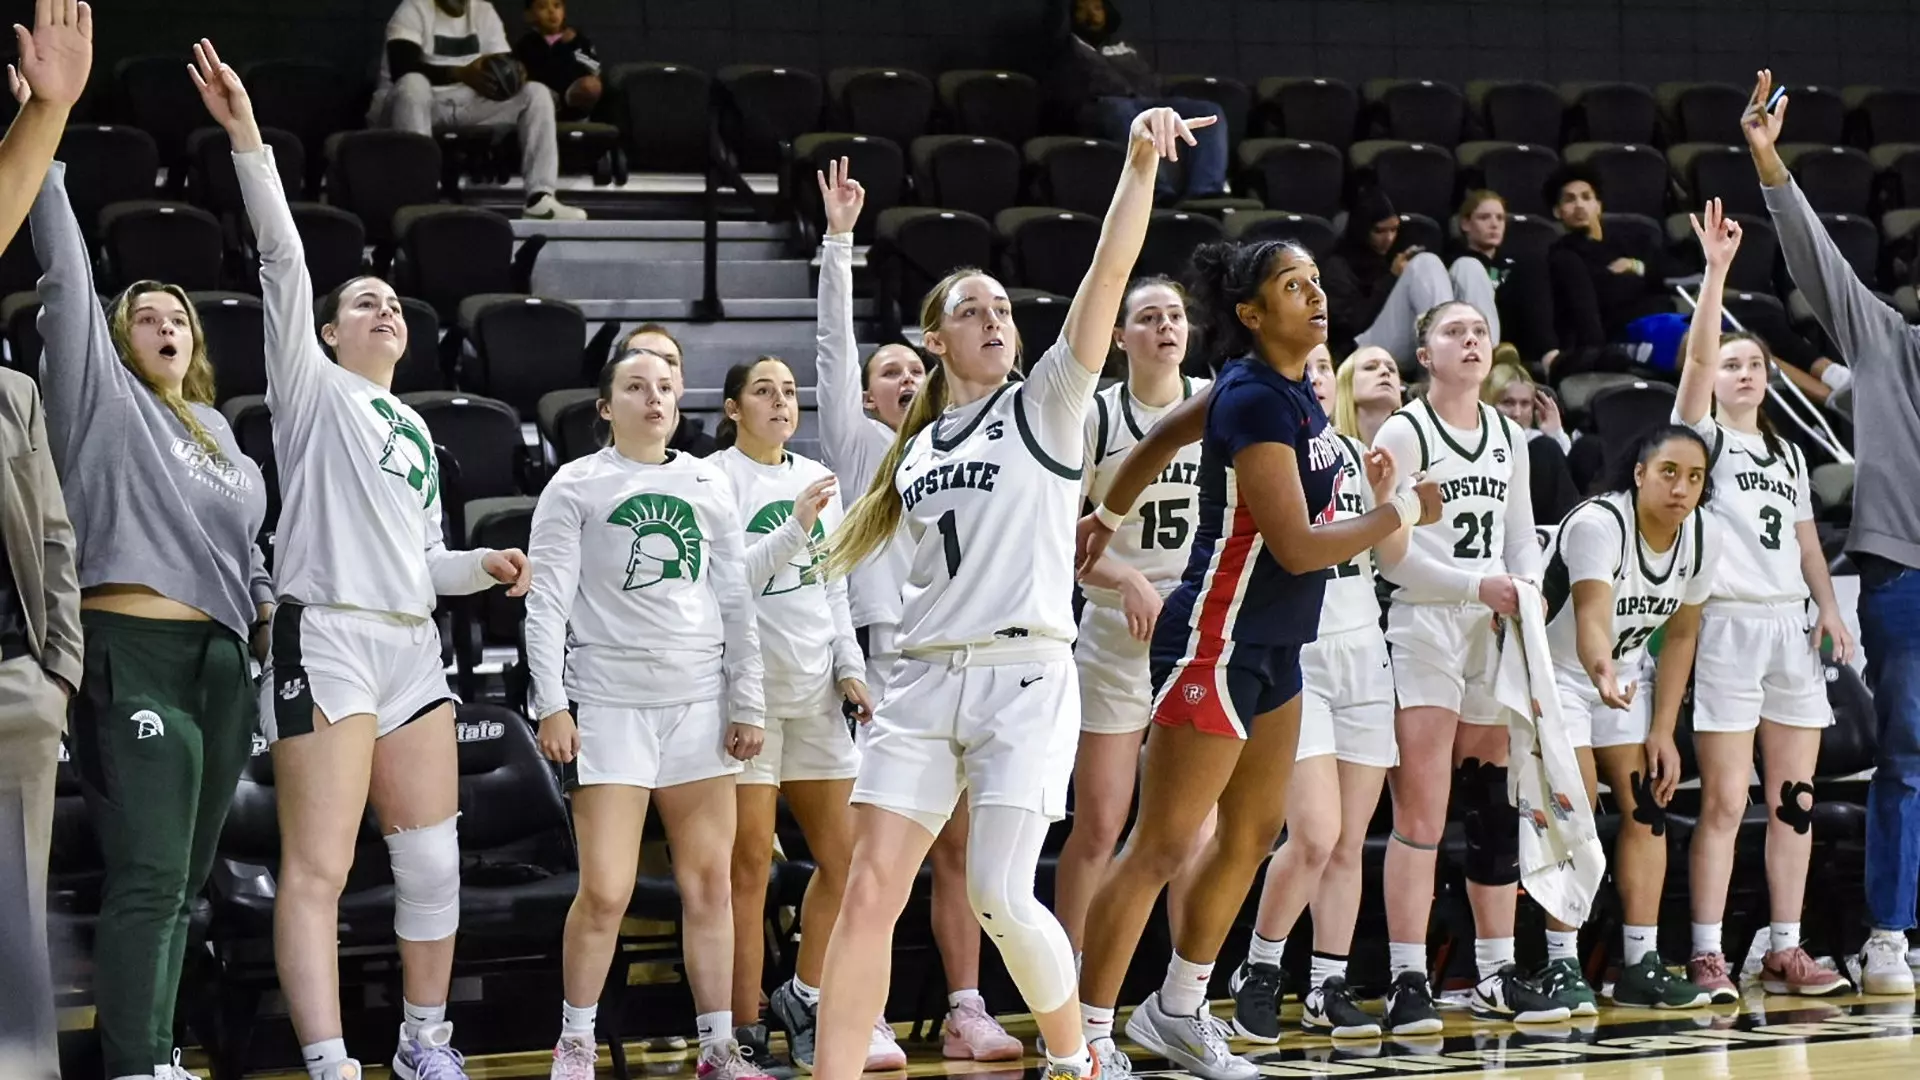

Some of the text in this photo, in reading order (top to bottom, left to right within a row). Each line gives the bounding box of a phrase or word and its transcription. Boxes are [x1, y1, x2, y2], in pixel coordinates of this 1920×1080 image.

[902, 461, 1000, 512] UPSTATE
[937, 509, 961, 580] 1
[1139, 498, 1190, 549] 15
[1453, 511, 1493, 558] 21
[1759, 505, 1782, 550] 3
[1612, 627, 1656, 660] 13
